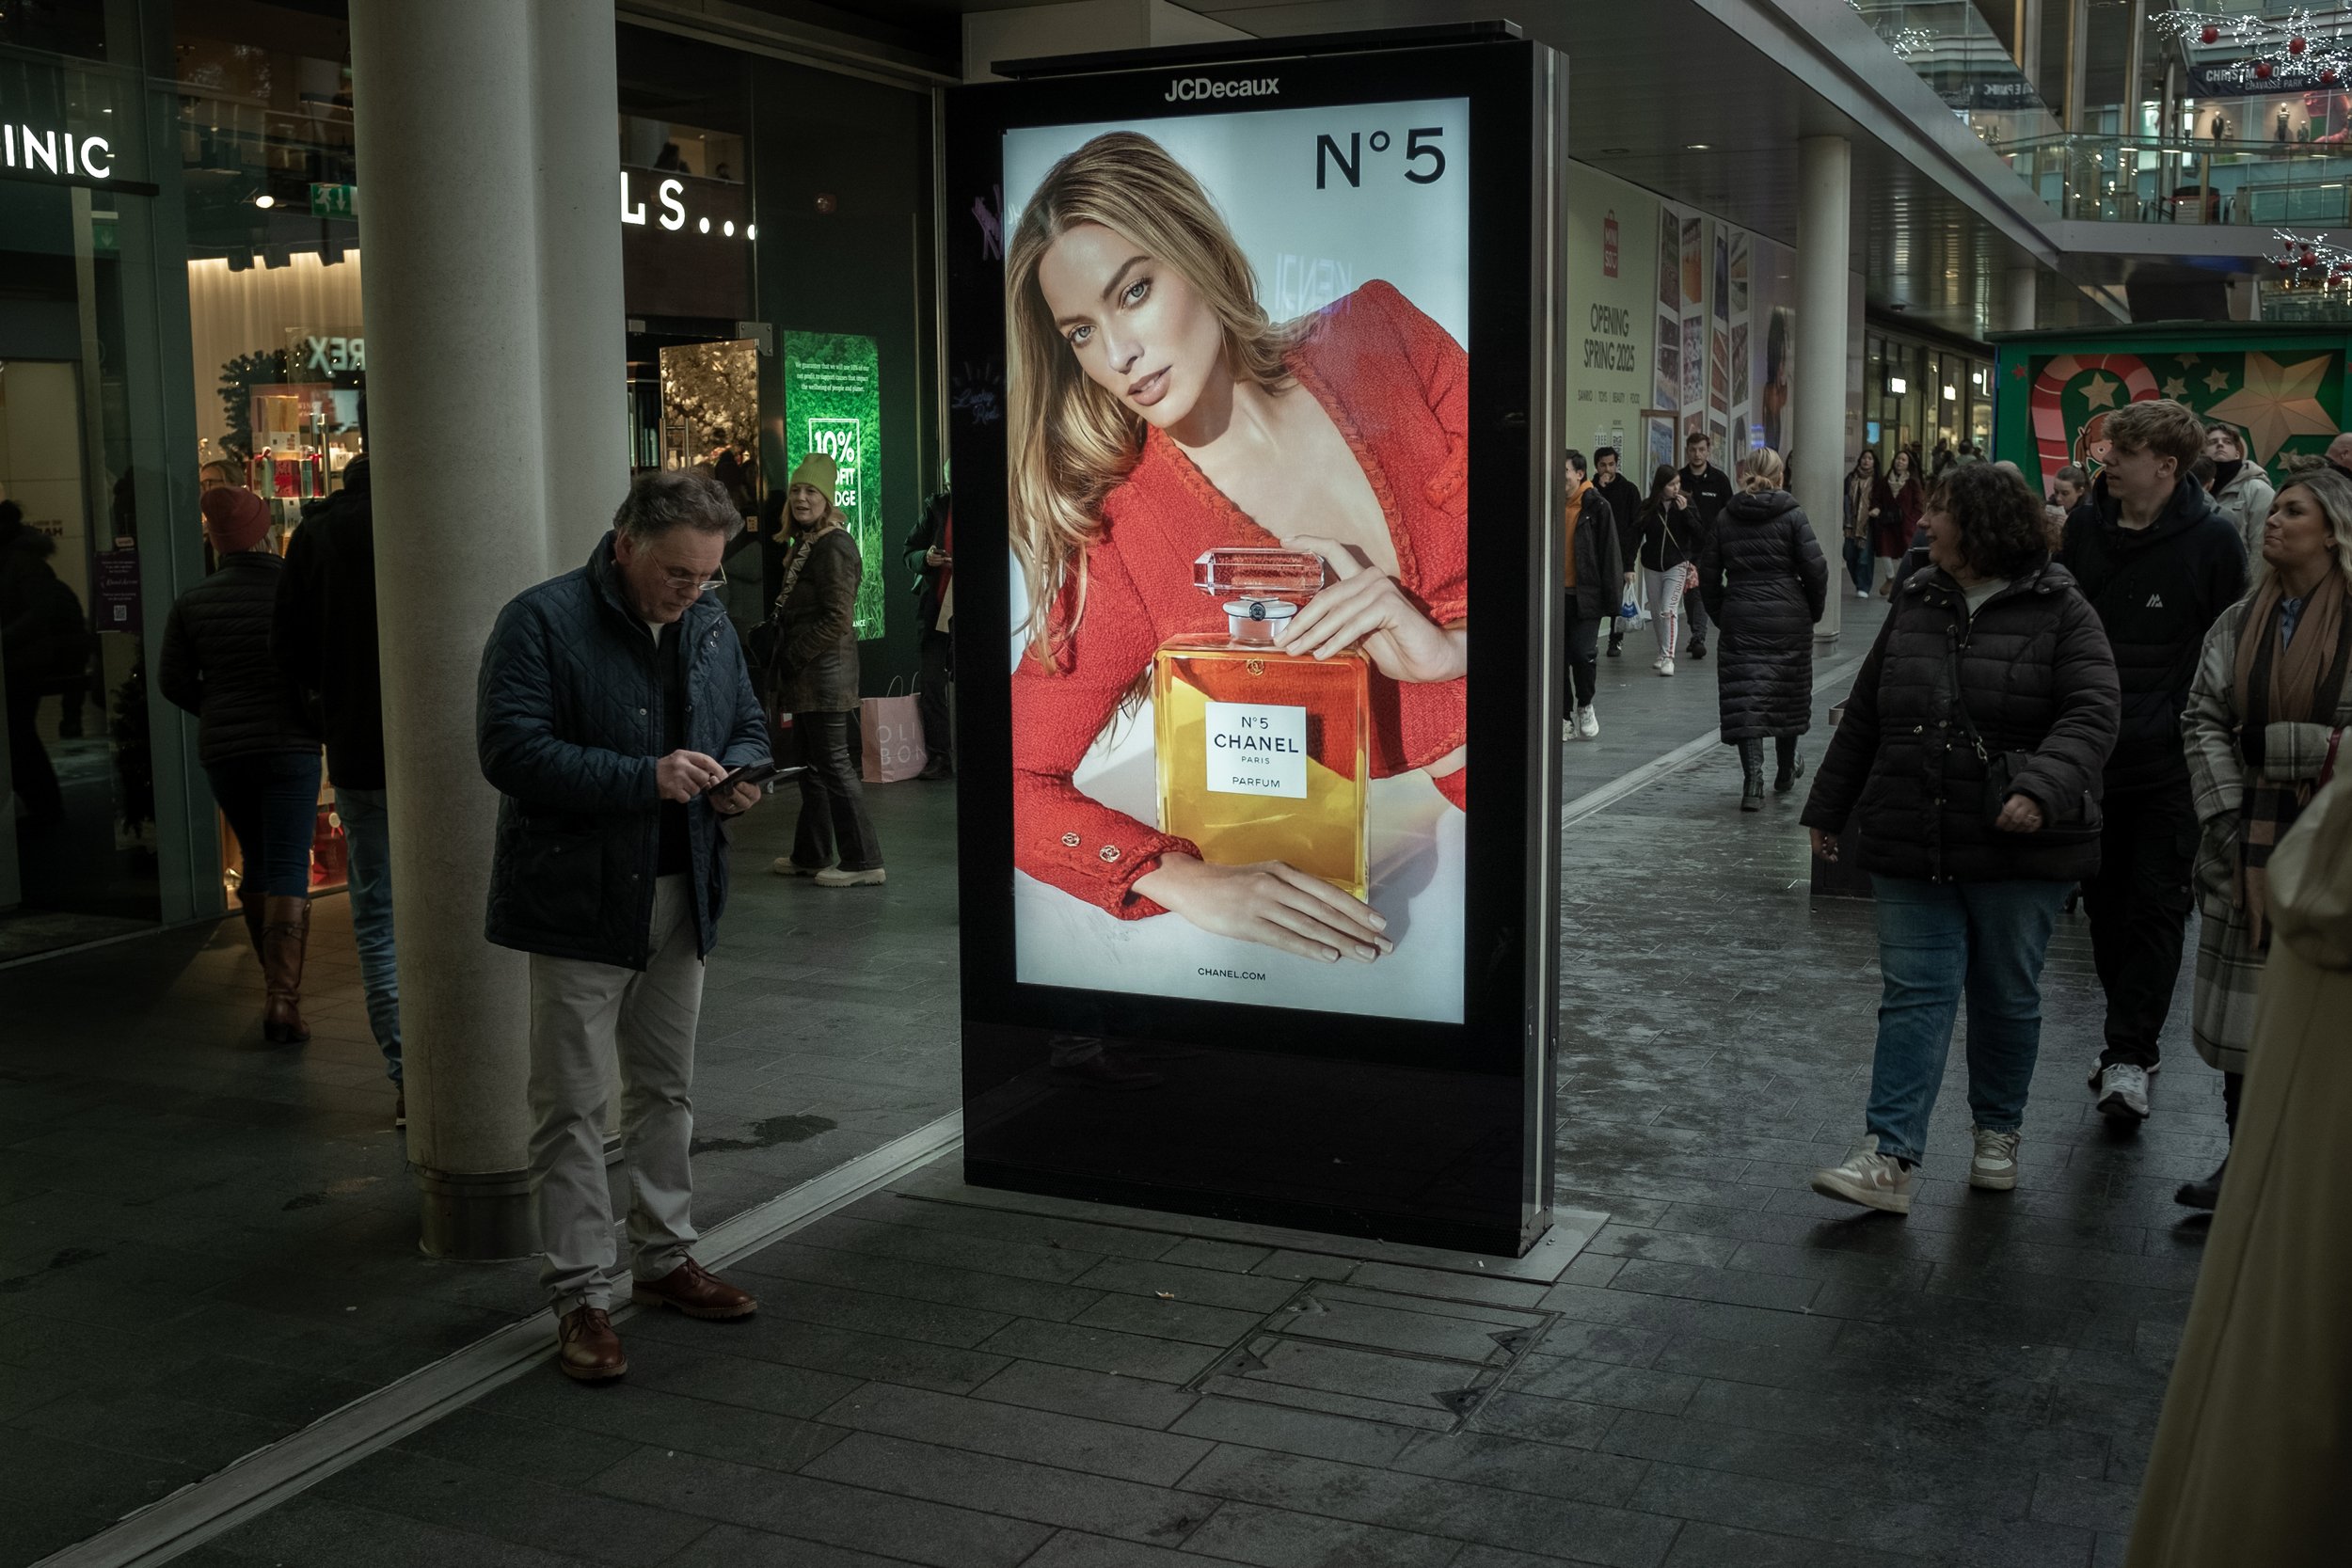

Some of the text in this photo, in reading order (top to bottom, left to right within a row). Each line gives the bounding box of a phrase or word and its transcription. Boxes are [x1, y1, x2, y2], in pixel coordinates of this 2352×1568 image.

[1165, 77, 1279, 102] JCDecaux
[2283, 79, 2303, 88] PARK
[1590, 303, 1629, 337] OPENING
[1584, 339, 1635, 372] SPRING 2025
[814, 429, 855, 462] 10%
[1214, 734, 1299, 753] CHANEL
[1241, 756, 1270, 765] PARIS
[1232, 776, 1280, 788] PARFUM
[1198, 967, 1266, 981] CHANEL.COM
